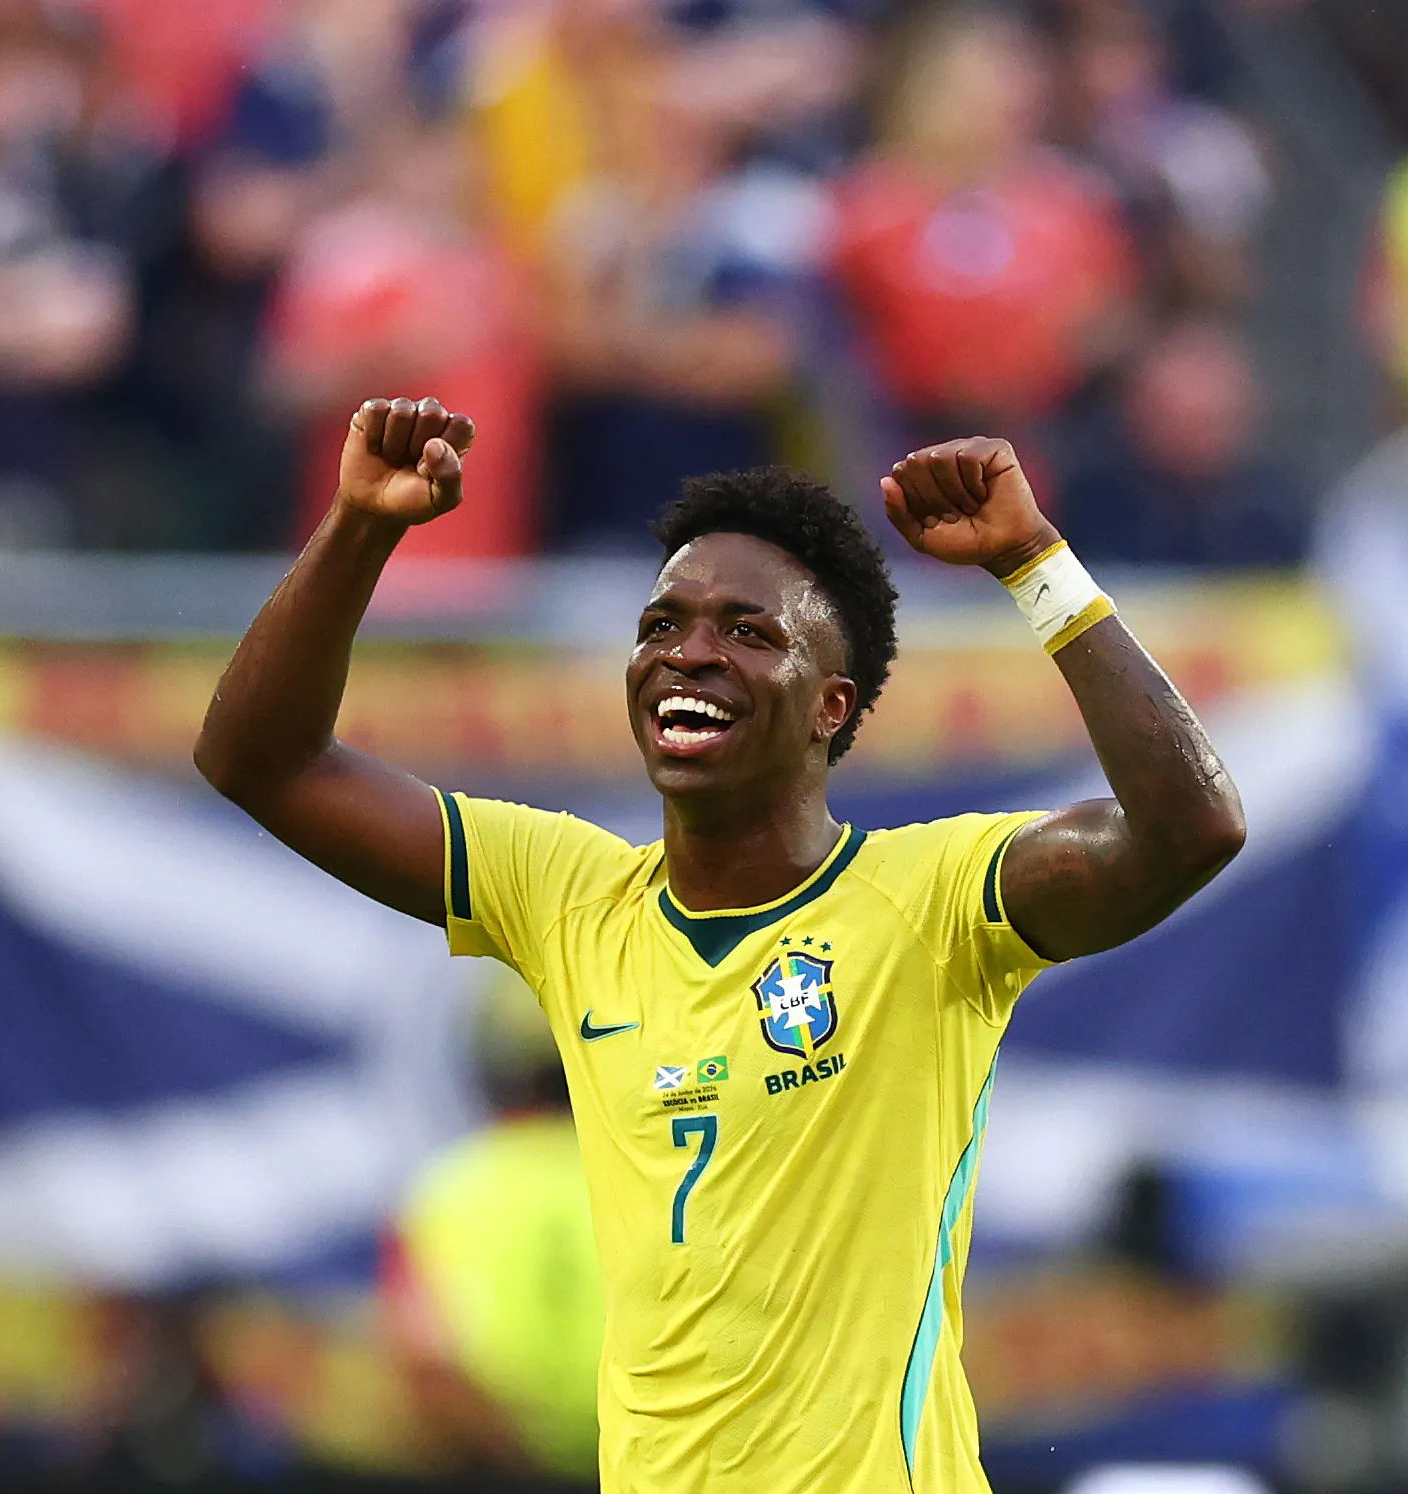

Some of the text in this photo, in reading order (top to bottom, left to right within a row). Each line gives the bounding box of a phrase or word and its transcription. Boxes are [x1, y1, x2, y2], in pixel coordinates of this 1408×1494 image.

[780, 991, 809, 1010] CBF
[765, 1053, 847, 1095] BRASIL
[671, 1114, 718, 1244] 7
